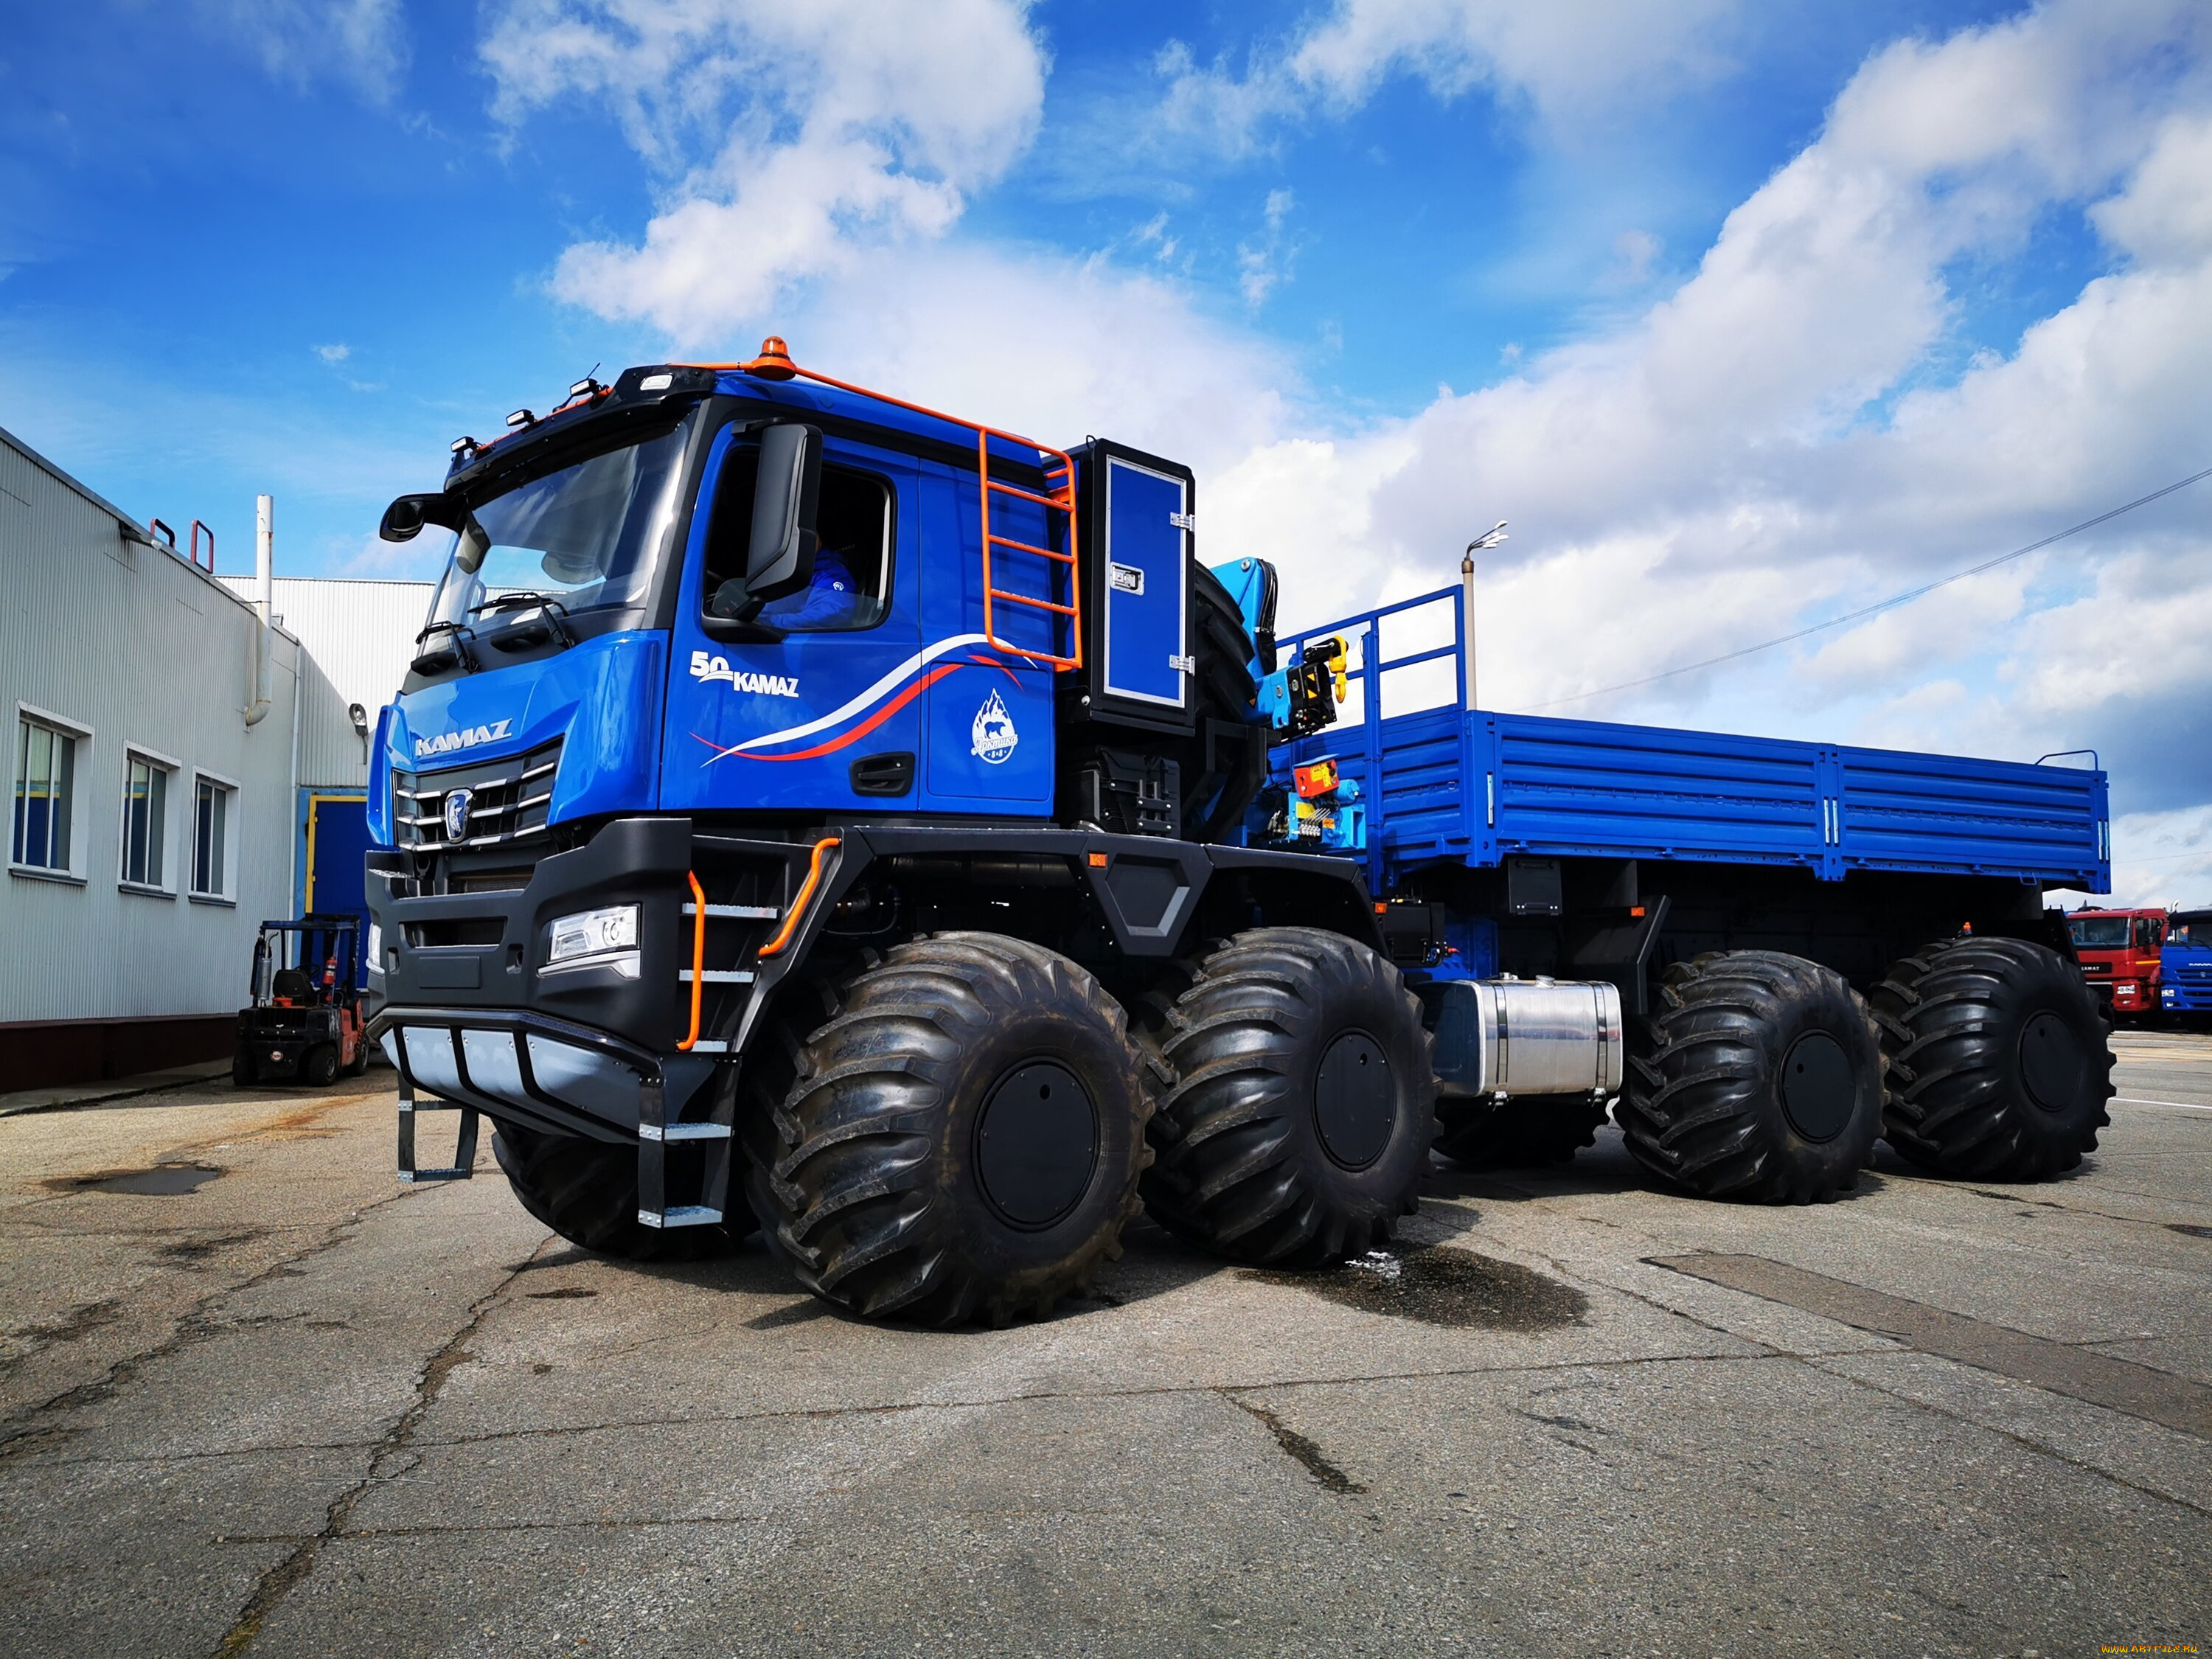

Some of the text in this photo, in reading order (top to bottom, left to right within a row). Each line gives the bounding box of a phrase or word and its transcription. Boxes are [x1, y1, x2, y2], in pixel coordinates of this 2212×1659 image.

[689, 651, 730, 677] 50
[734, 672, 799, 698] KAMAZ
[415, 718, 512, 757] KAMAZ
[973, 735, 1018, 754] Арктика
